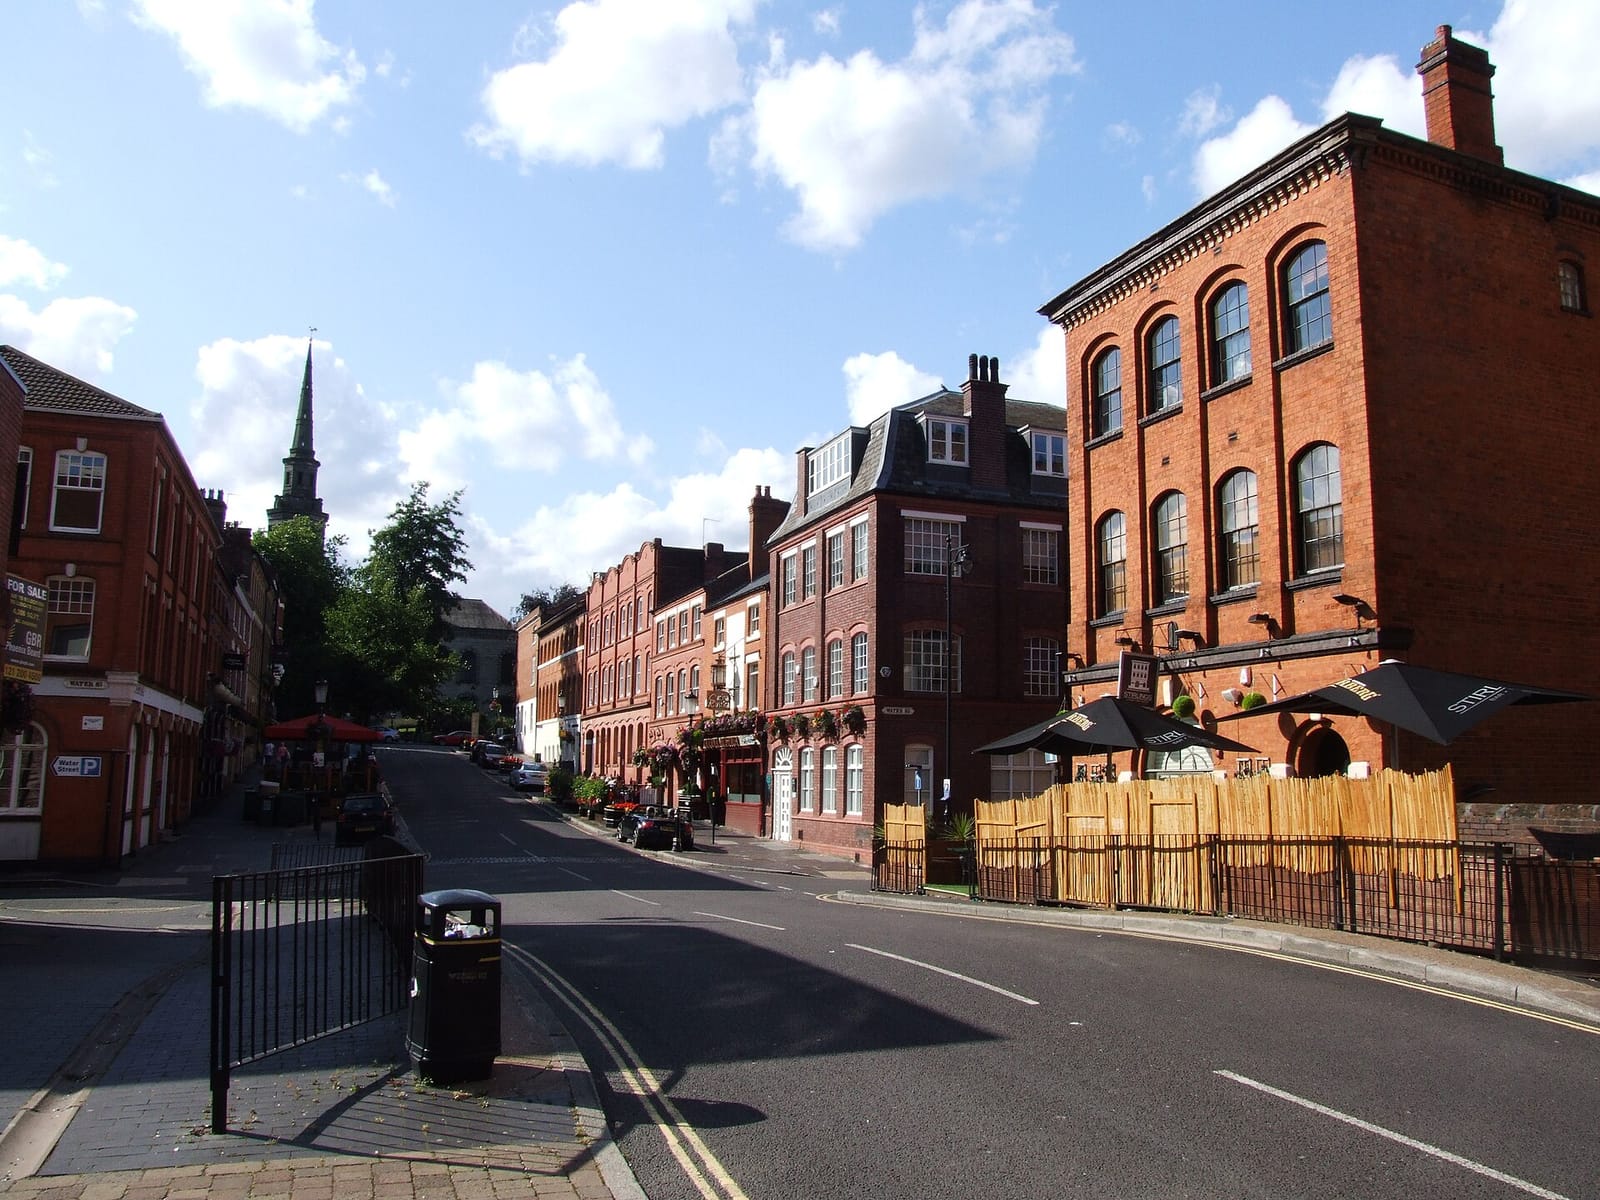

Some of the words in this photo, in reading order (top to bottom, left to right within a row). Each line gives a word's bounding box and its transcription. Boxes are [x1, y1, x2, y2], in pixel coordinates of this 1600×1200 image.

[7, 578, 25, 594] FOR
[26, 585, 48, 601] SALE
[25, 631, 42, 648] GBR
[70, 680, 93, 688] WATER
[1447, 685, 1502, 713] STIRL
[1143, 730, 1185, 744] STIRL
[84, 759, 97, 774] P
